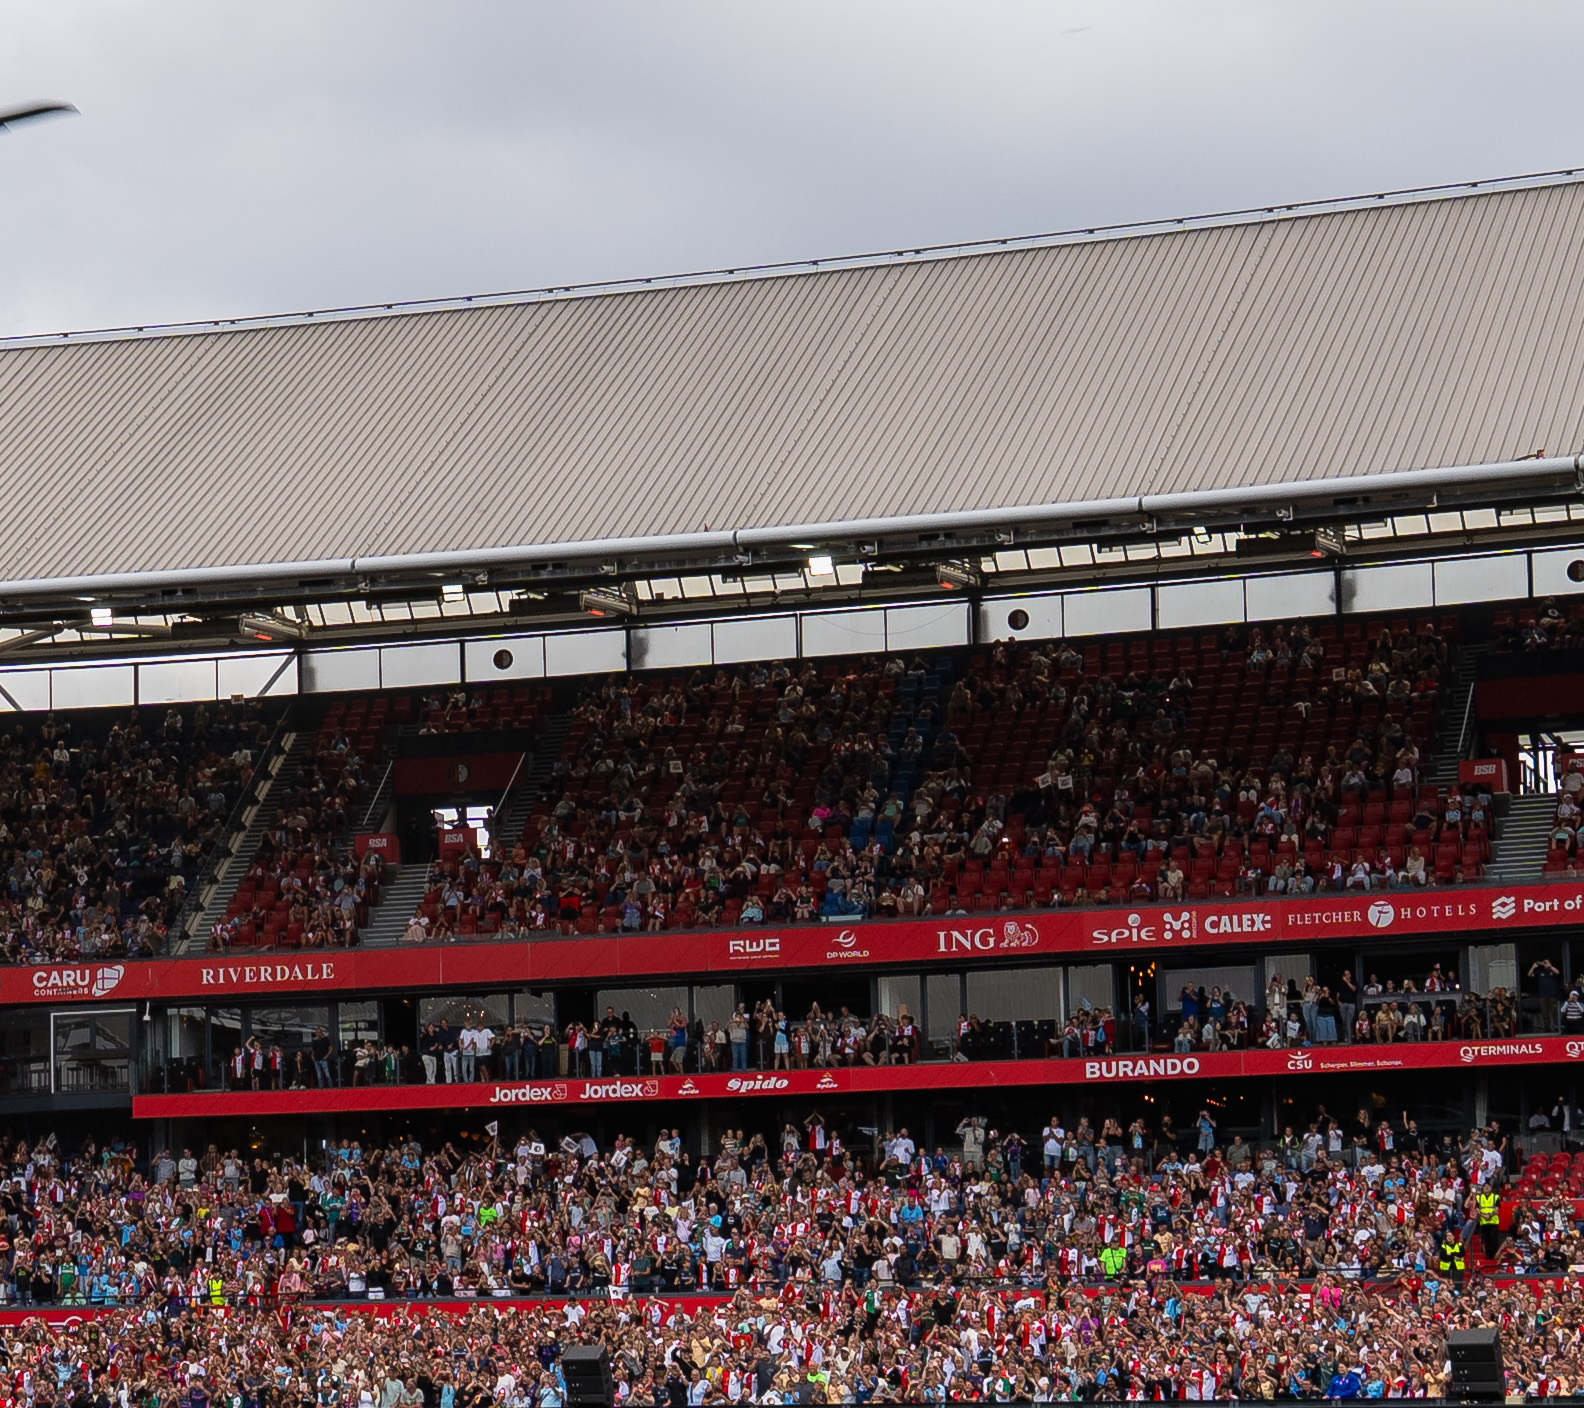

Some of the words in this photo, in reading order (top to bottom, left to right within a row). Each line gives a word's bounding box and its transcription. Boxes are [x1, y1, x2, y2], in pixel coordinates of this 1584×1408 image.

[1287, 908, 1363, 927] FLETCHER
[1400, 902, 1478, 922] HOTELS
[1523, 896, 1557, 915] Port
[1561, 895, 1582, 913] of
[729, 939, 780, 953] RWG
[937, 927, 996, 953] ING
[32, 970, 91, 989] CARU
[200, 962, 336, 985] RIVERDALE
[1084, 1056, 1200, 1079] BURANDO
[1287, 1059, 1313, 1070] CSU
[489, 1083, 552, 1104] Jordex
[579, 1079, 643, 1101] Jordex
[726, 1073, 789, 1094] Spido
